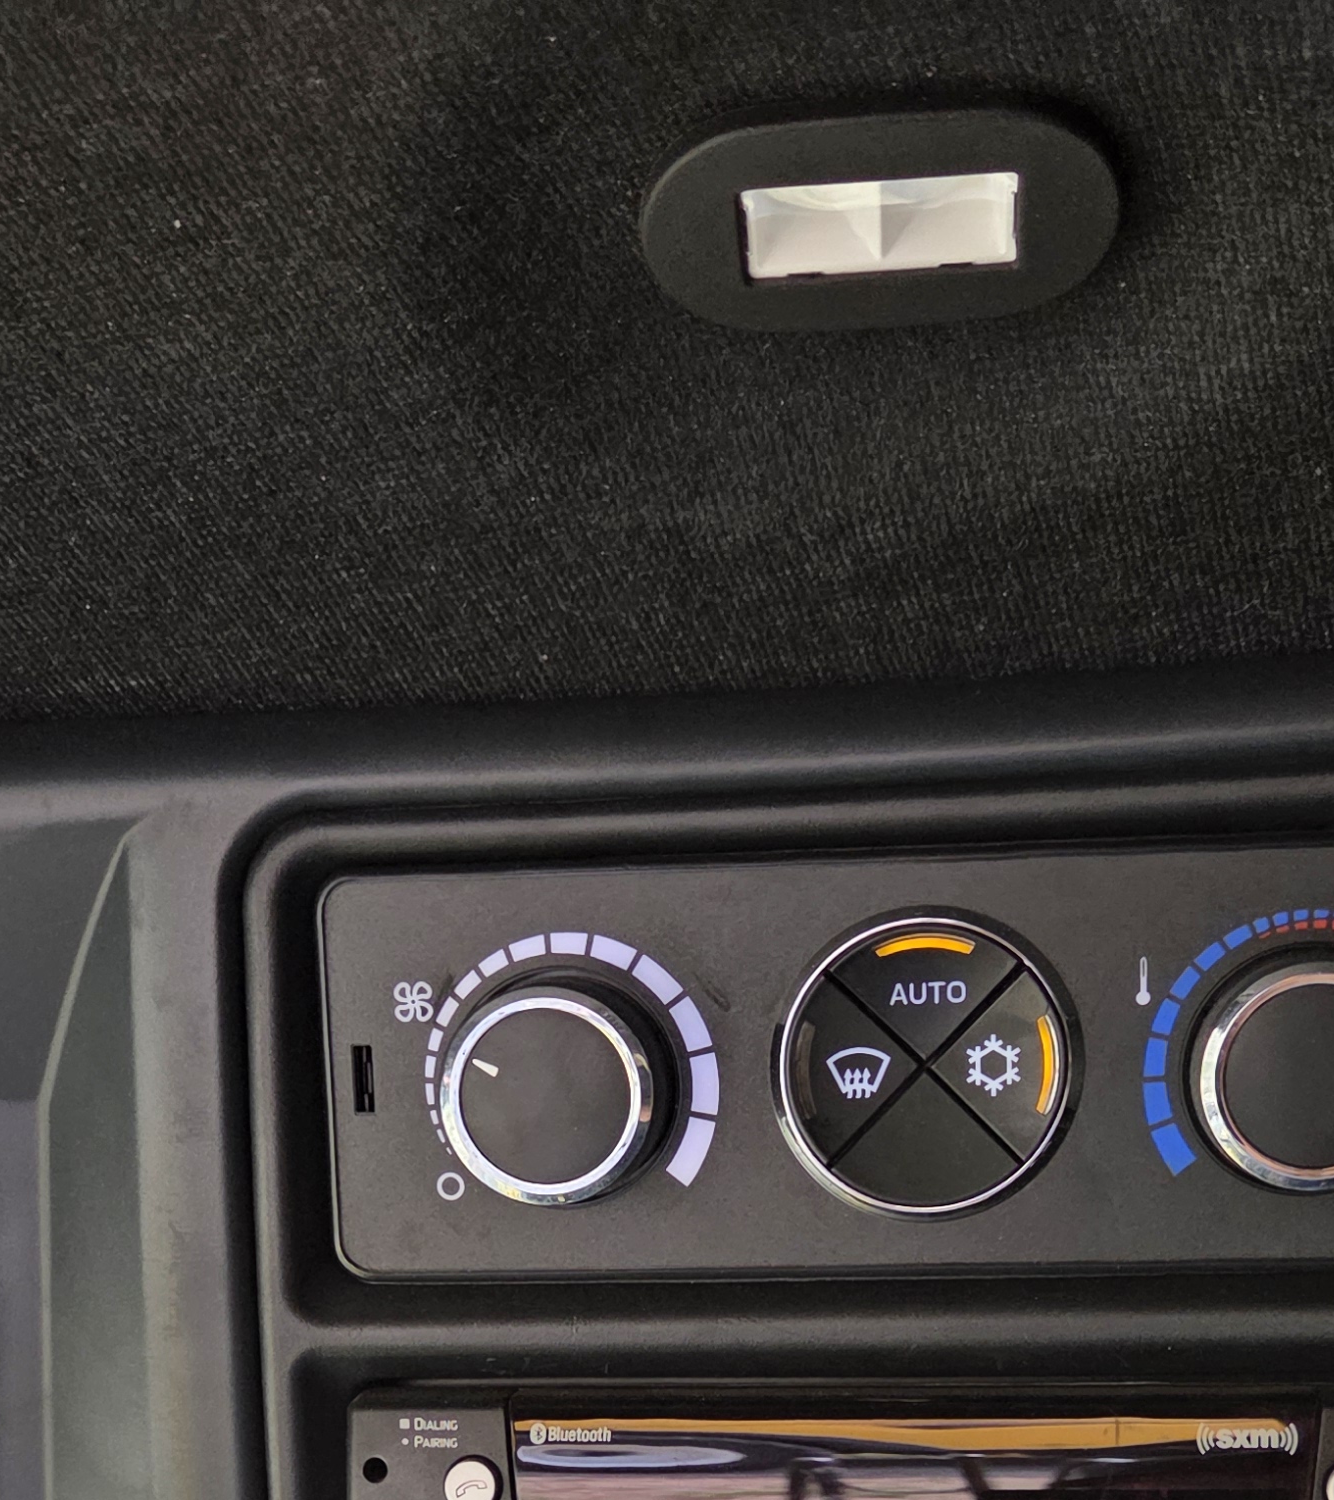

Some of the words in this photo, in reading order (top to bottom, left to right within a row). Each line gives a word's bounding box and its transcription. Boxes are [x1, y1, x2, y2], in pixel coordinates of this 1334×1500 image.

[890, 980, 967, 1005] AUTO
[413, 1418, 458, 1432] DIALING
[413, 1435, 458, 1449] PAIRING
[548, 1426, 611, 1443] Bluetooth
